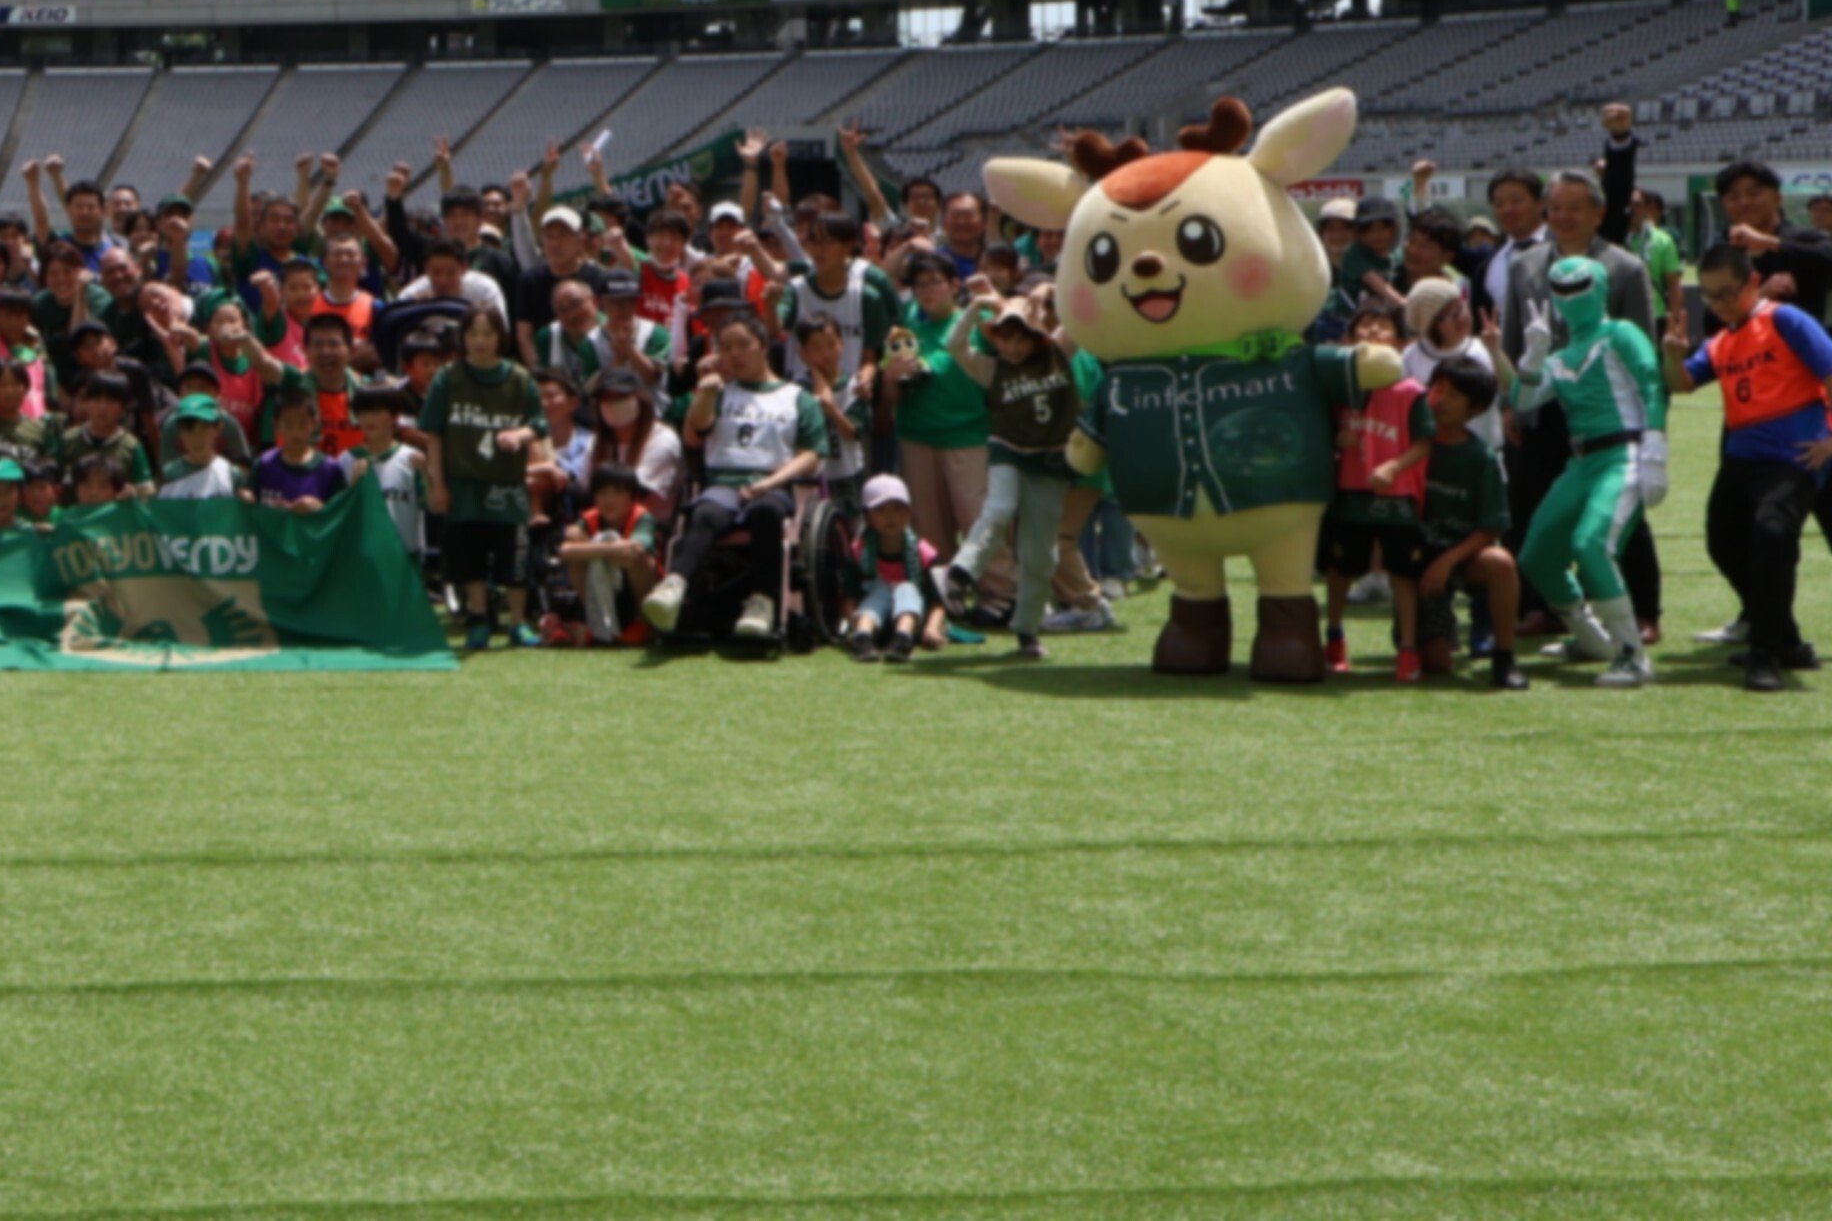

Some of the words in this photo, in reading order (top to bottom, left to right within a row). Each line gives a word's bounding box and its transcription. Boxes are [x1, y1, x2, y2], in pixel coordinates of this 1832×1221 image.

[1736, 377, 1752, 403] 6
[1033, 393, 1053, 424] 5
[477, 430, 495, 460] 4
